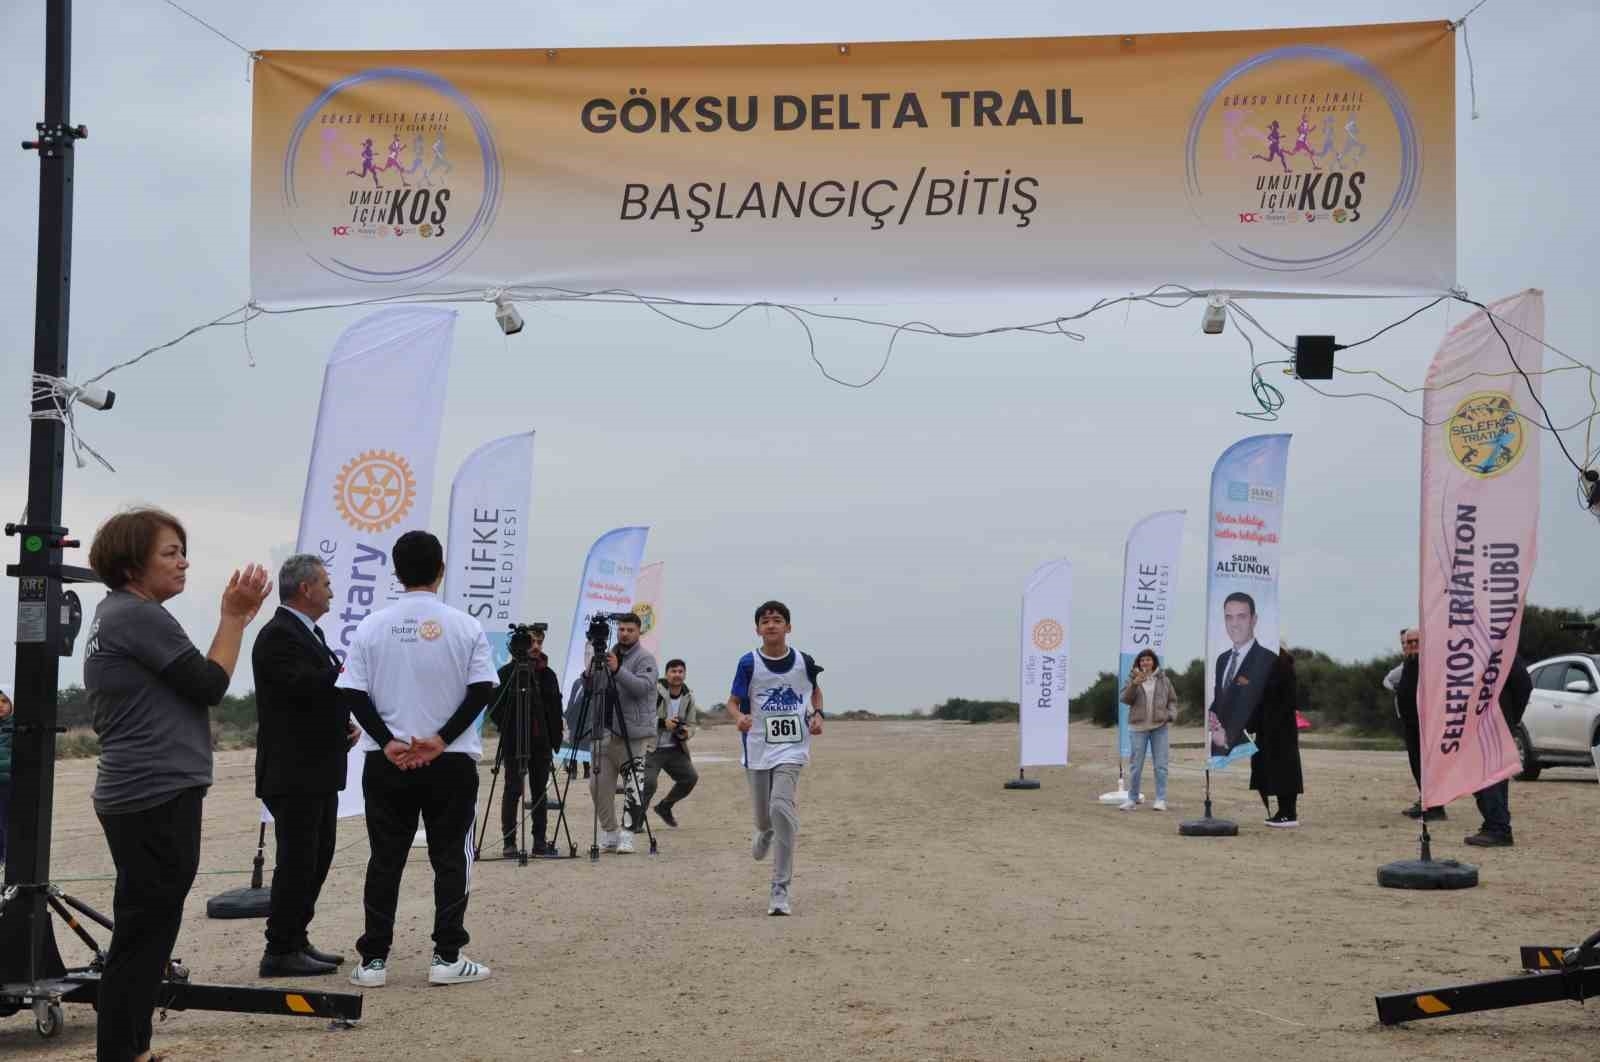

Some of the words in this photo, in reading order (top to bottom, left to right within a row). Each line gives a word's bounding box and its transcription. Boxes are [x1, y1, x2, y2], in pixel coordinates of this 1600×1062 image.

[581, 88, 758, 134] GÖKSU
[773, 92, 928, 131] DELTA
[941, 88, 1084, 127] TRAIL
[349, 190, 393, 205] UMUT
[387, 188, 450, 237] KOŞ
[620, 167, 1040, 233] BAŞLANGIÇ/BİTİŞ
[1256, 175, 1301, 190] UMUT
[1298, 171, 1365, 222] KOŞ
[463, 508, 499, 619] SİLİFKE
[1216, 561, 1271, 576] ALTUNOK
[1444, 504, 1477, 628] TRİATLON
[1482, 543, 1520, 640] KULÜBÜ
[1130, 562, 1159, 646] SİLİFKE
[1038, 656, 1056, 708] Rotary
[1441, 638, 1474, 754] SELEFKOS
[1475, 649, 1503, 716] SPOR
[771, 719, 797, 737] 361
